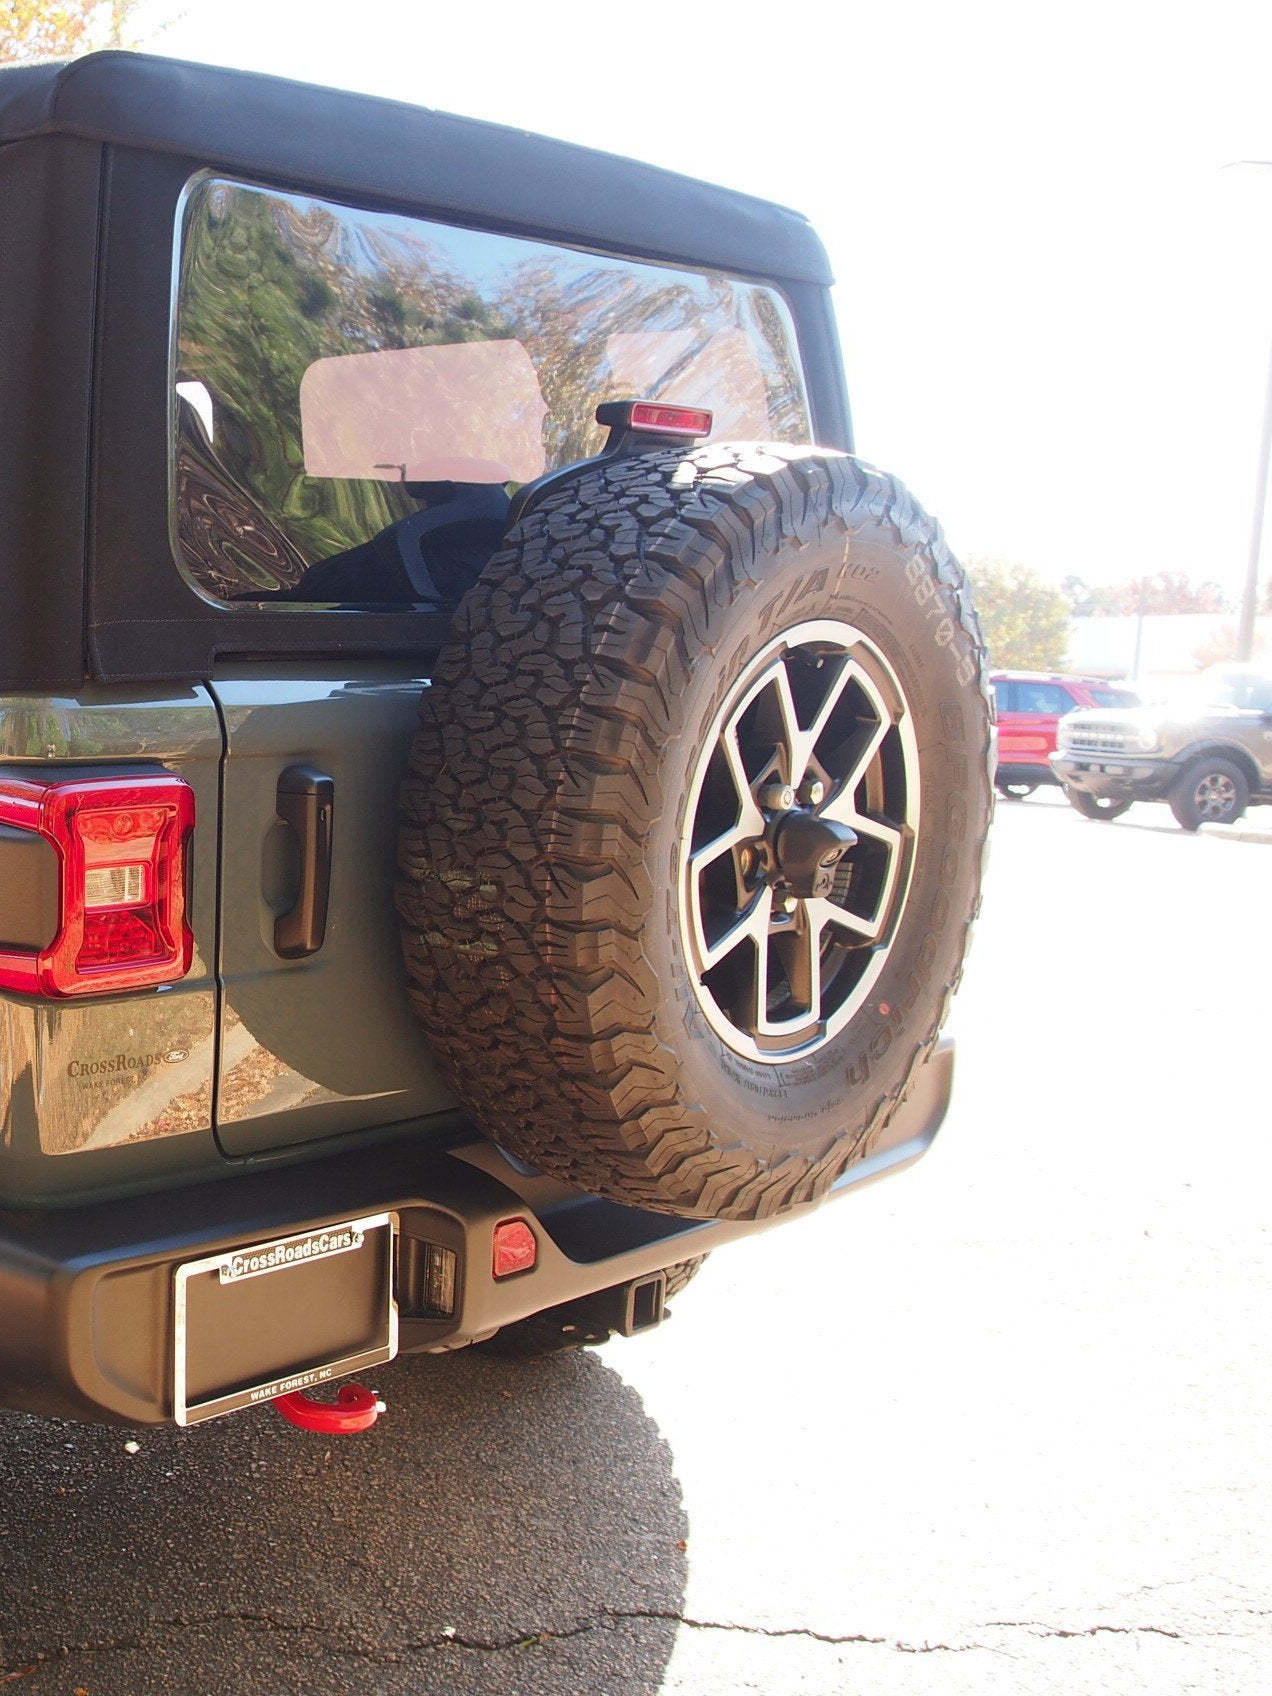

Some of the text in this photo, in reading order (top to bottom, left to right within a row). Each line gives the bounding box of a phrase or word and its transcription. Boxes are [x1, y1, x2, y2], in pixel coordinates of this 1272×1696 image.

[758, 566, 830, 637] T/A
[844, 701, 969, 1089] BFGoodrich
[81, 1080, 104, 1090] WAKE
[232, 1231, 352, 1275] CrossRoadsCars
[250, 1368, 333, 1401] WAKE FOREST, NC
